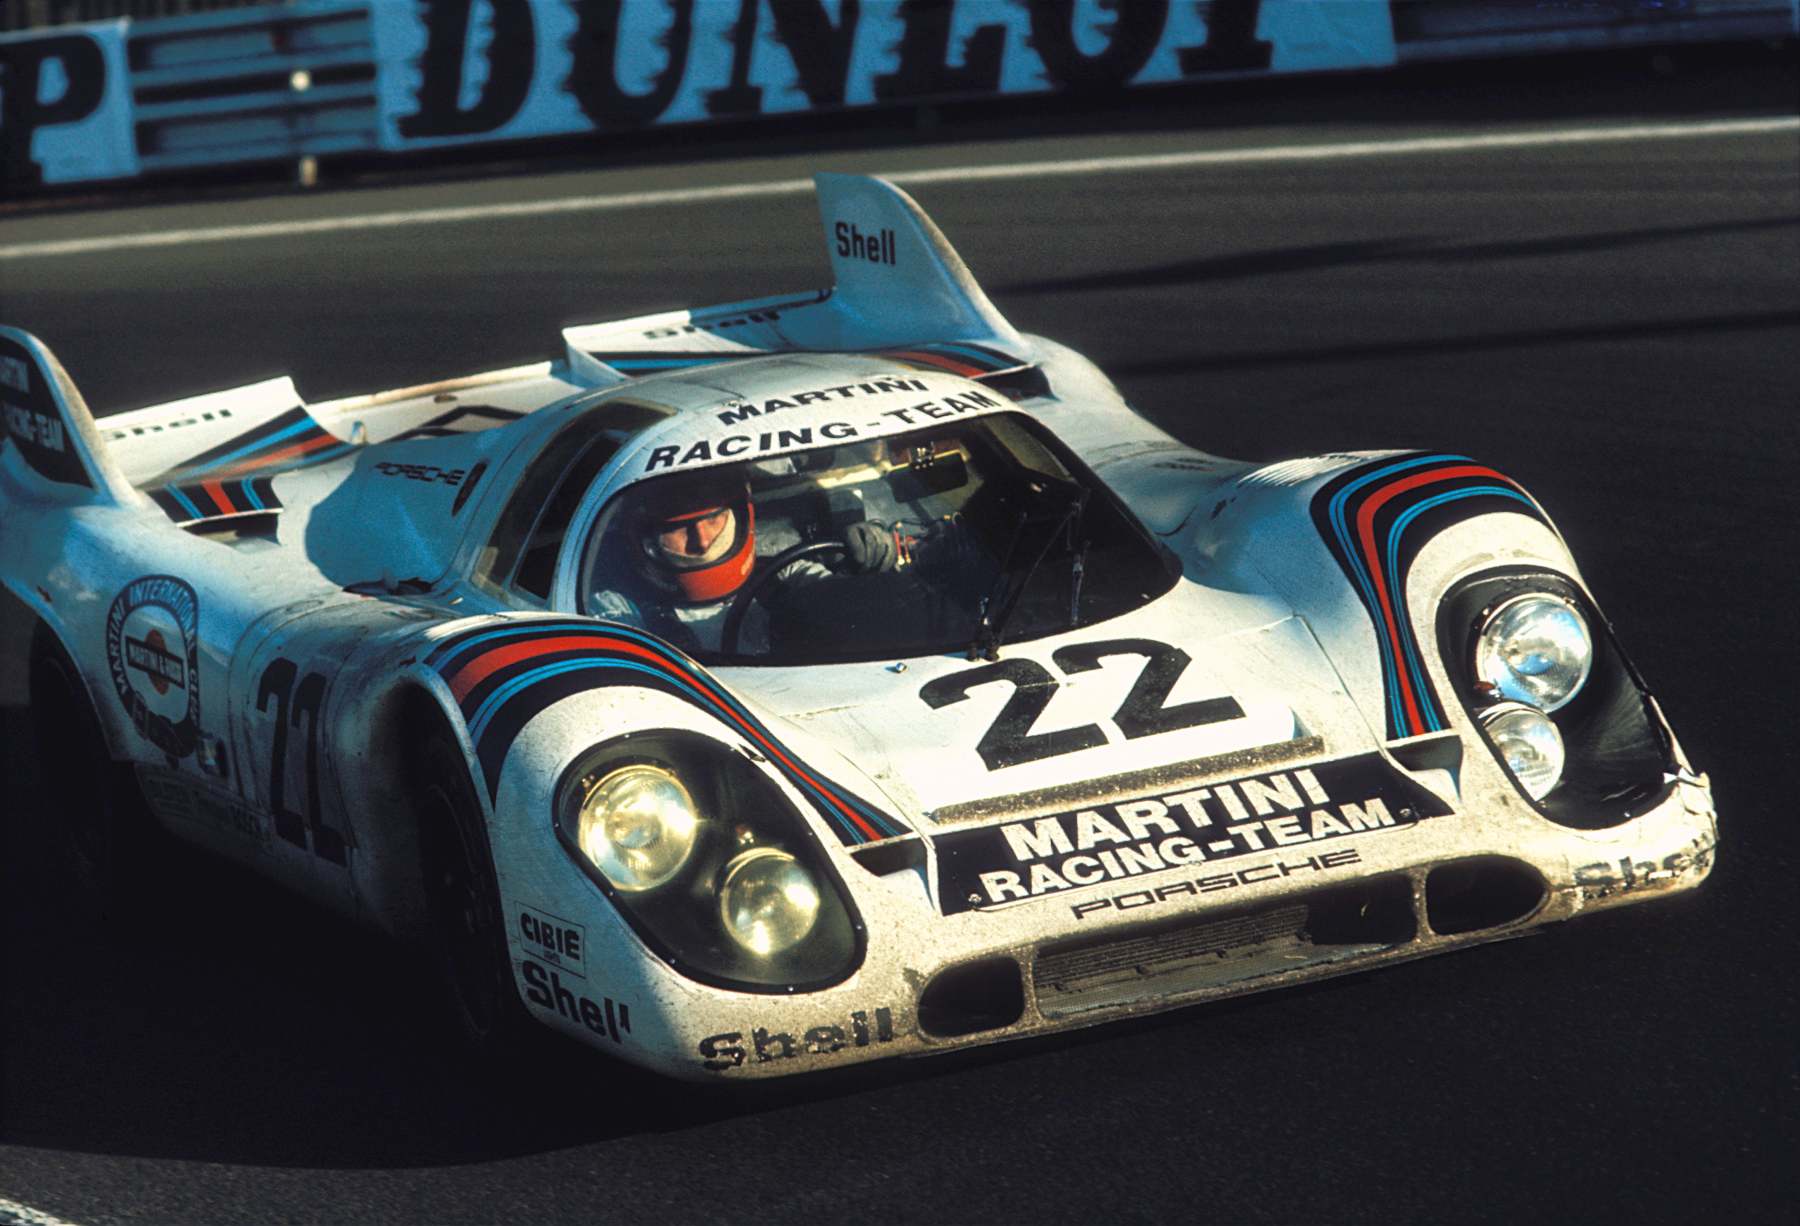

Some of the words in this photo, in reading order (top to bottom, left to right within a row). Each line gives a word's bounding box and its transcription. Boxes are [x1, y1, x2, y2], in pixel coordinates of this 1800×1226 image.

[835, 221, 896, 266] Shell
[645, 390, 1003, 472] RACING-TEAM
[717, 379, 930, 426] MARTINI
[373, 461, 466, 486] PORSCHE
[919, 637, 1247, 772] 22
[256, 657, 348, 868] 22
[978, 797, 1396, 903] RACING-TEAM
[1000, 768, 1331, 862] MARTINI
[1071, 848, 1362, 920] PORSCHE
[522, 960, 632, 1044] Shell
[699, 1006, 893, 1071] Shell
